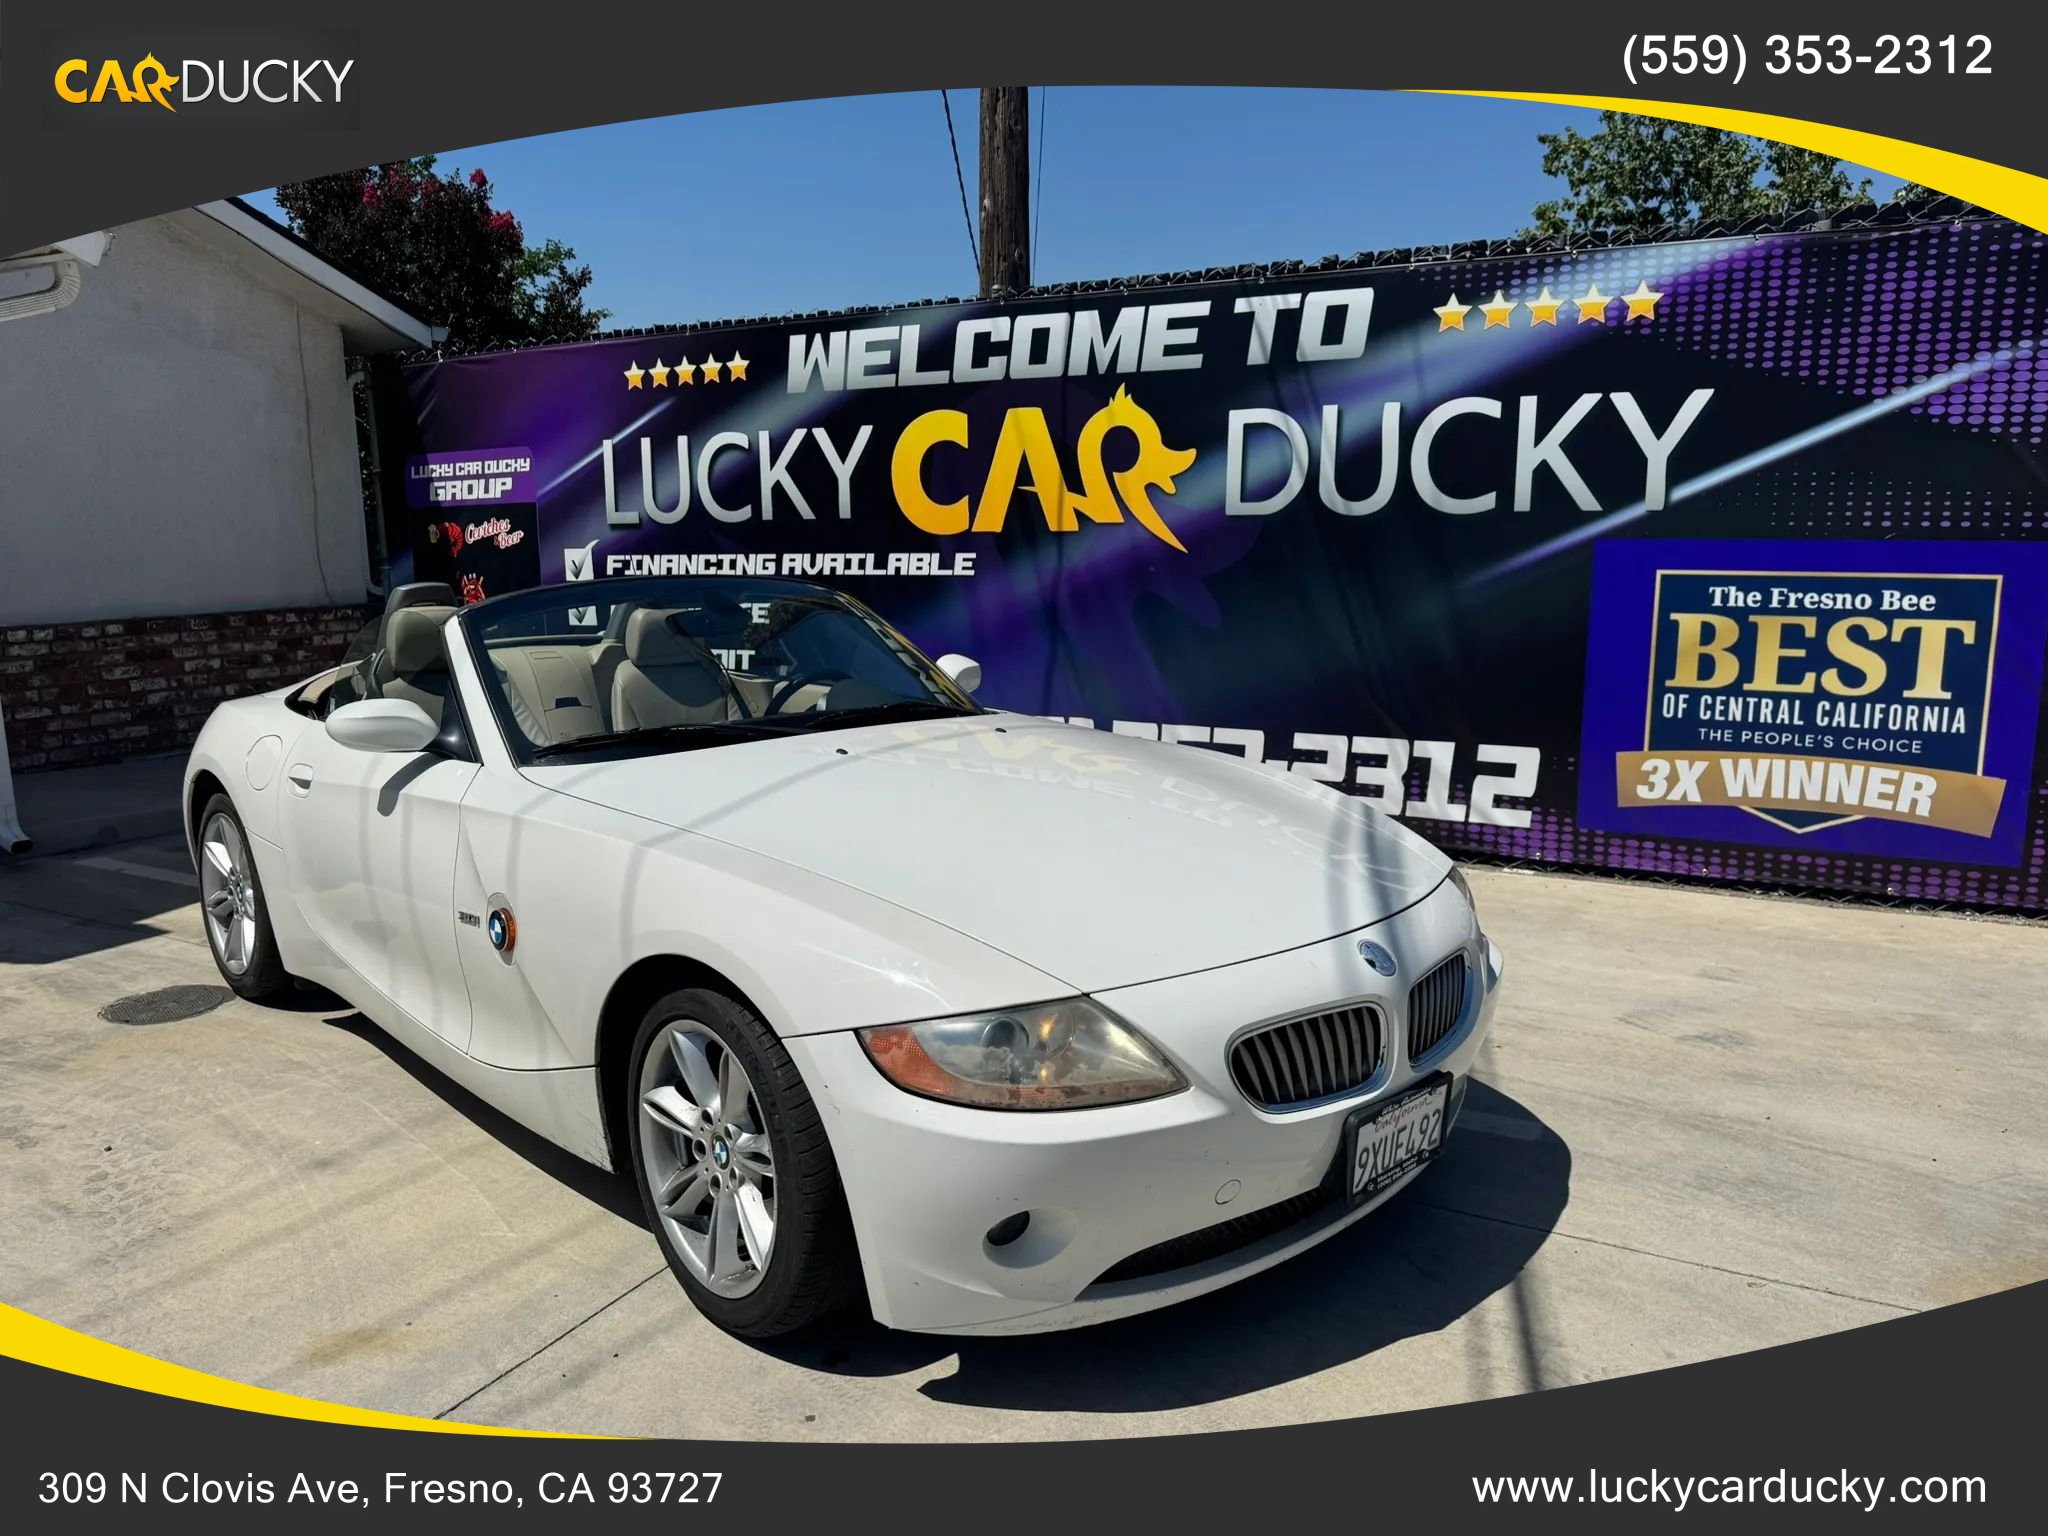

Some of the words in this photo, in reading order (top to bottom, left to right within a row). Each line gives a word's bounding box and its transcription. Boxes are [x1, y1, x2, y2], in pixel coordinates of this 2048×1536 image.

[786, 300, 1211, 395] WELCOME
[1233, 287, 1375, 366] TO
[411, 462, 454, 479] LUCKY
[456, 461, 482, 476] CAR
[484, 457, 530, 474] DUCKY
[602, 425, 873, 526] LUCKY
[891, 382, 1197, 554] CAR
[1225, 388, 1715, 516] DUCKY
[430, 477, 513, 501] GROUP
[465, 517, 511, 544] Ceviches
[499, 530, 525, 549] Beer
[606, 553, 776, 576] FINANCING
[782, 552, 976, 576] AVAILABLE
[1709, 586, 1762, 609] The
[1768, 587, 1872, 611] Fresno
[1880, 590, 1936, 612] Bee
[1664, 612, 1976, 700] BEST
[1662, 693, 1689, 718] OF
[1699, 695, 1804, 726] CENTRAL
[1816, 701, 1966, 734] CALIFORNIA
[1698, 728, 1733, 744] THE
[1741, 730, 1834, 749] PEOPLE'S
[1842, 736, 1923, 754] CHOICE
[1636, 758, 1710, 803] 3X
[1720, 757, 1937, 818] WINNER
